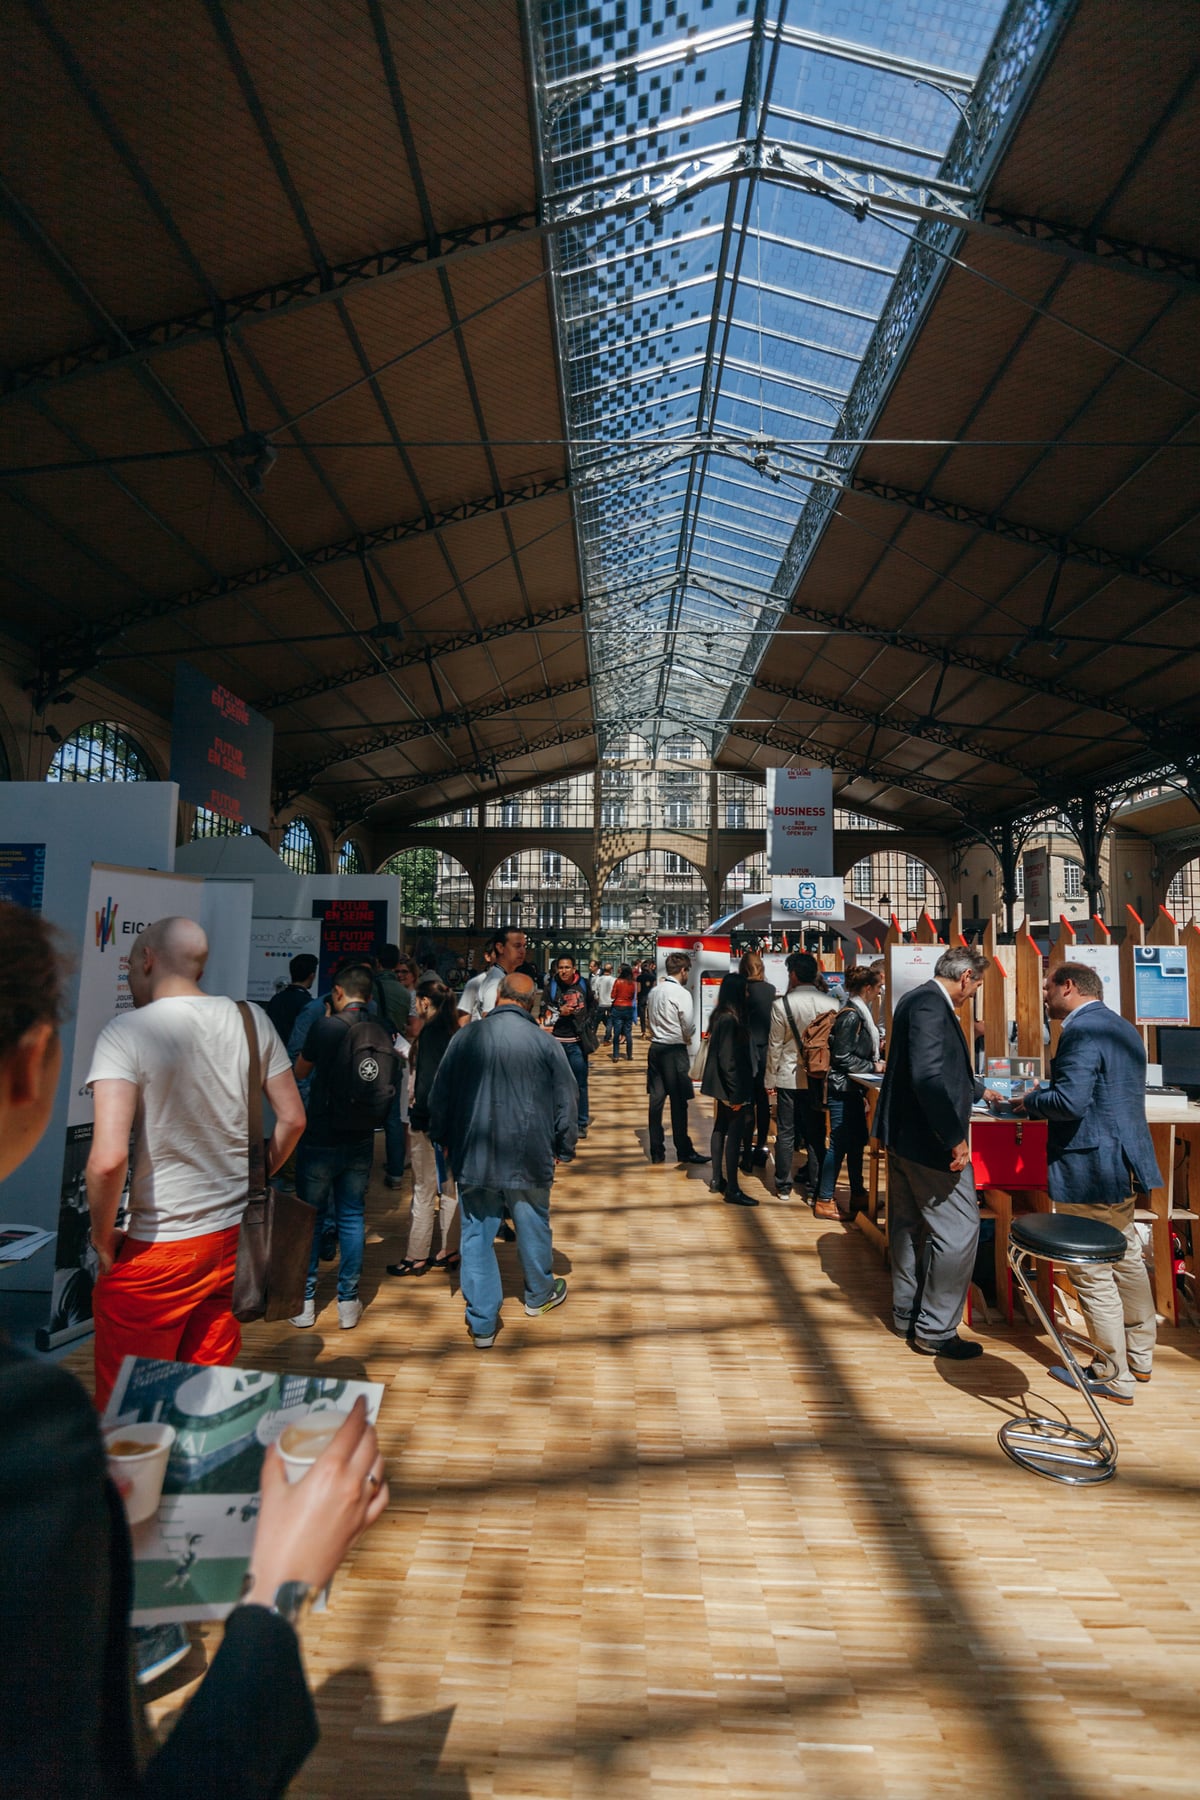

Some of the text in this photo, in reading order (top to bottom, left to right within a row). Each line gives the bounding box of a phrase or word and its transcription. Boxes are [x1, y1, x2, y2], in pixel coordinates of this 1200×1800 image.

[214, 736, 243, 763] FUTUR
[207, 748, 247, 779] EN SEINE
[211, 788, 240, 813] FUTUR
[774, 806, 826, 816] BUSINESS
[332, 900, 369, 911] FUTUR
[783, 898, 832, 911] zagatub
[325, 911, 375, 921] EN SEINE
[122, 921, 151, 934] EIC
[323, 930, 375, 941] LE FUTUR
[327, 941, 340, 951] SE
